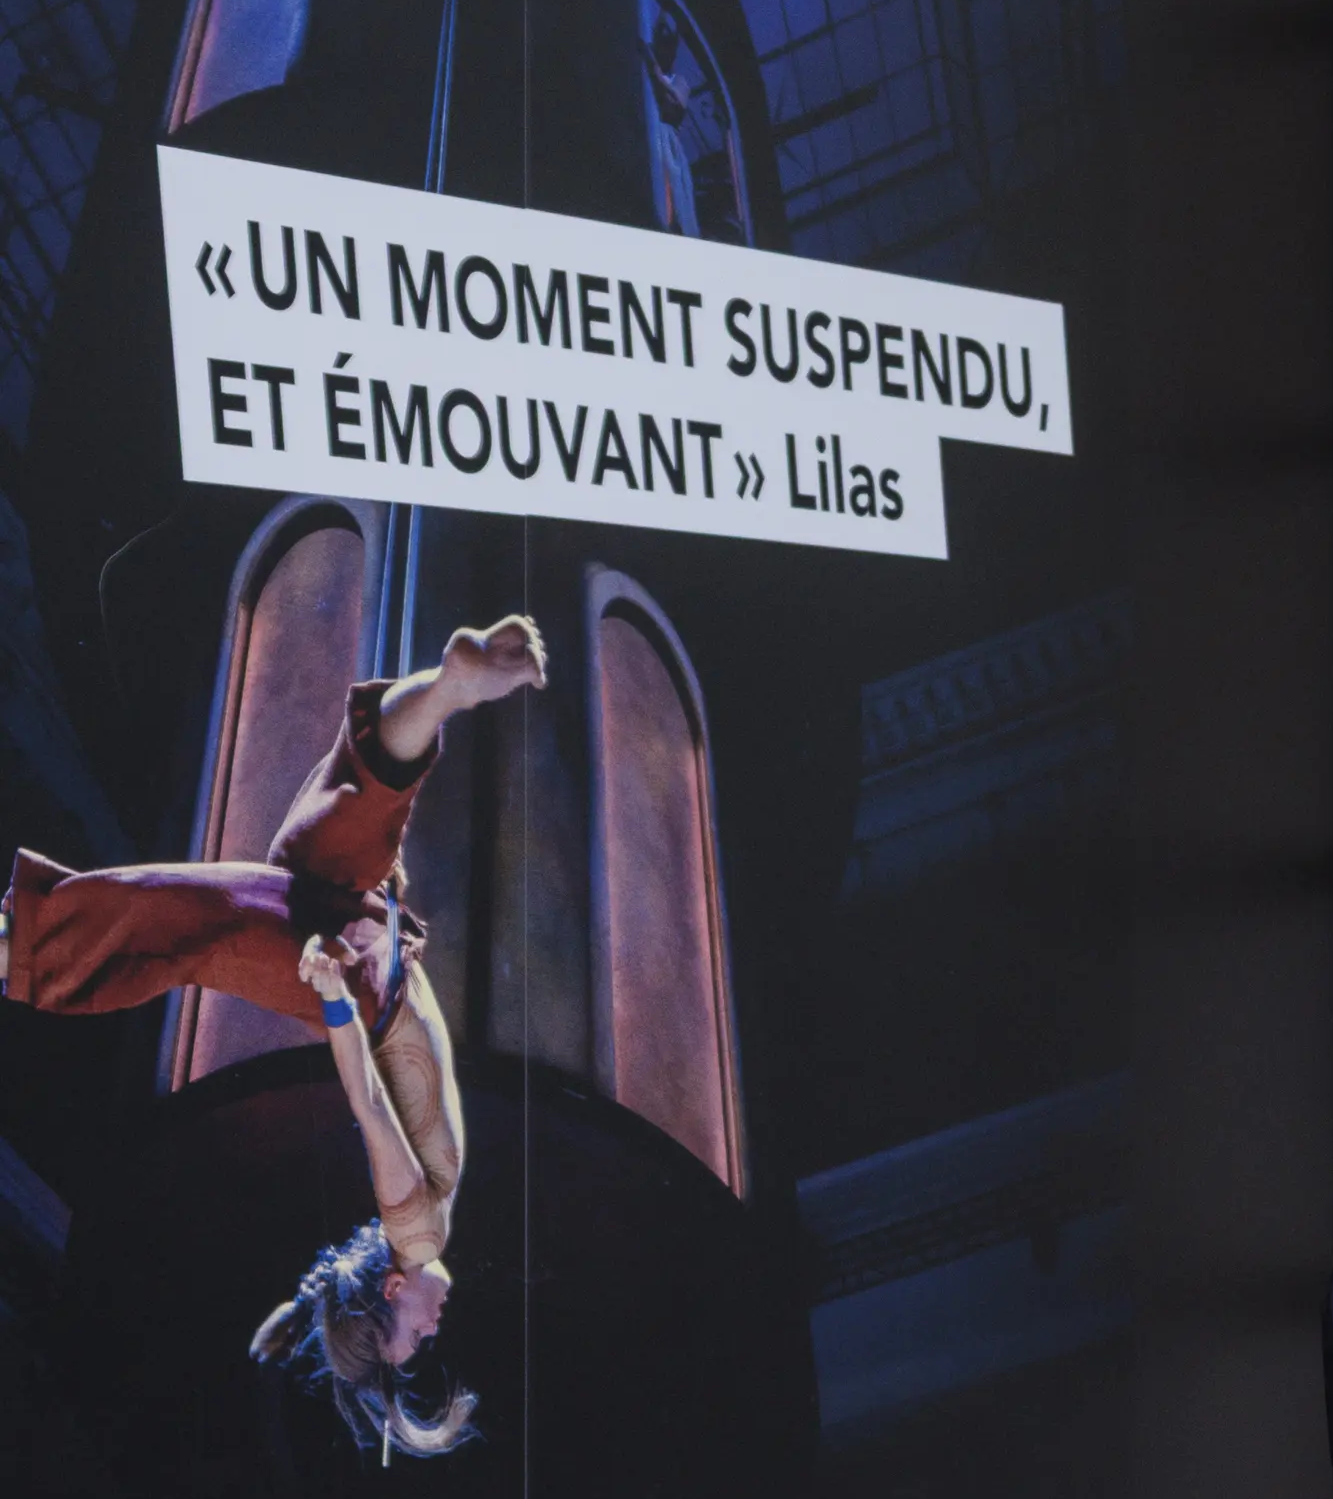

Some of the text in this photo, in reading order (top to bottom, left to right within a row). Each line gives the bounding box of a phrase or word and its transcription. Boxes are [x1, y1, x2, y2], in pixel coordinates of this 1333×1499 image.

[387, 242, 703, 369] MOMENT
[726, 298, 1051, 433] SUSPENDU,
[206, 357, 296, 452] ET
[785, 432, 905, 522] Lilas
